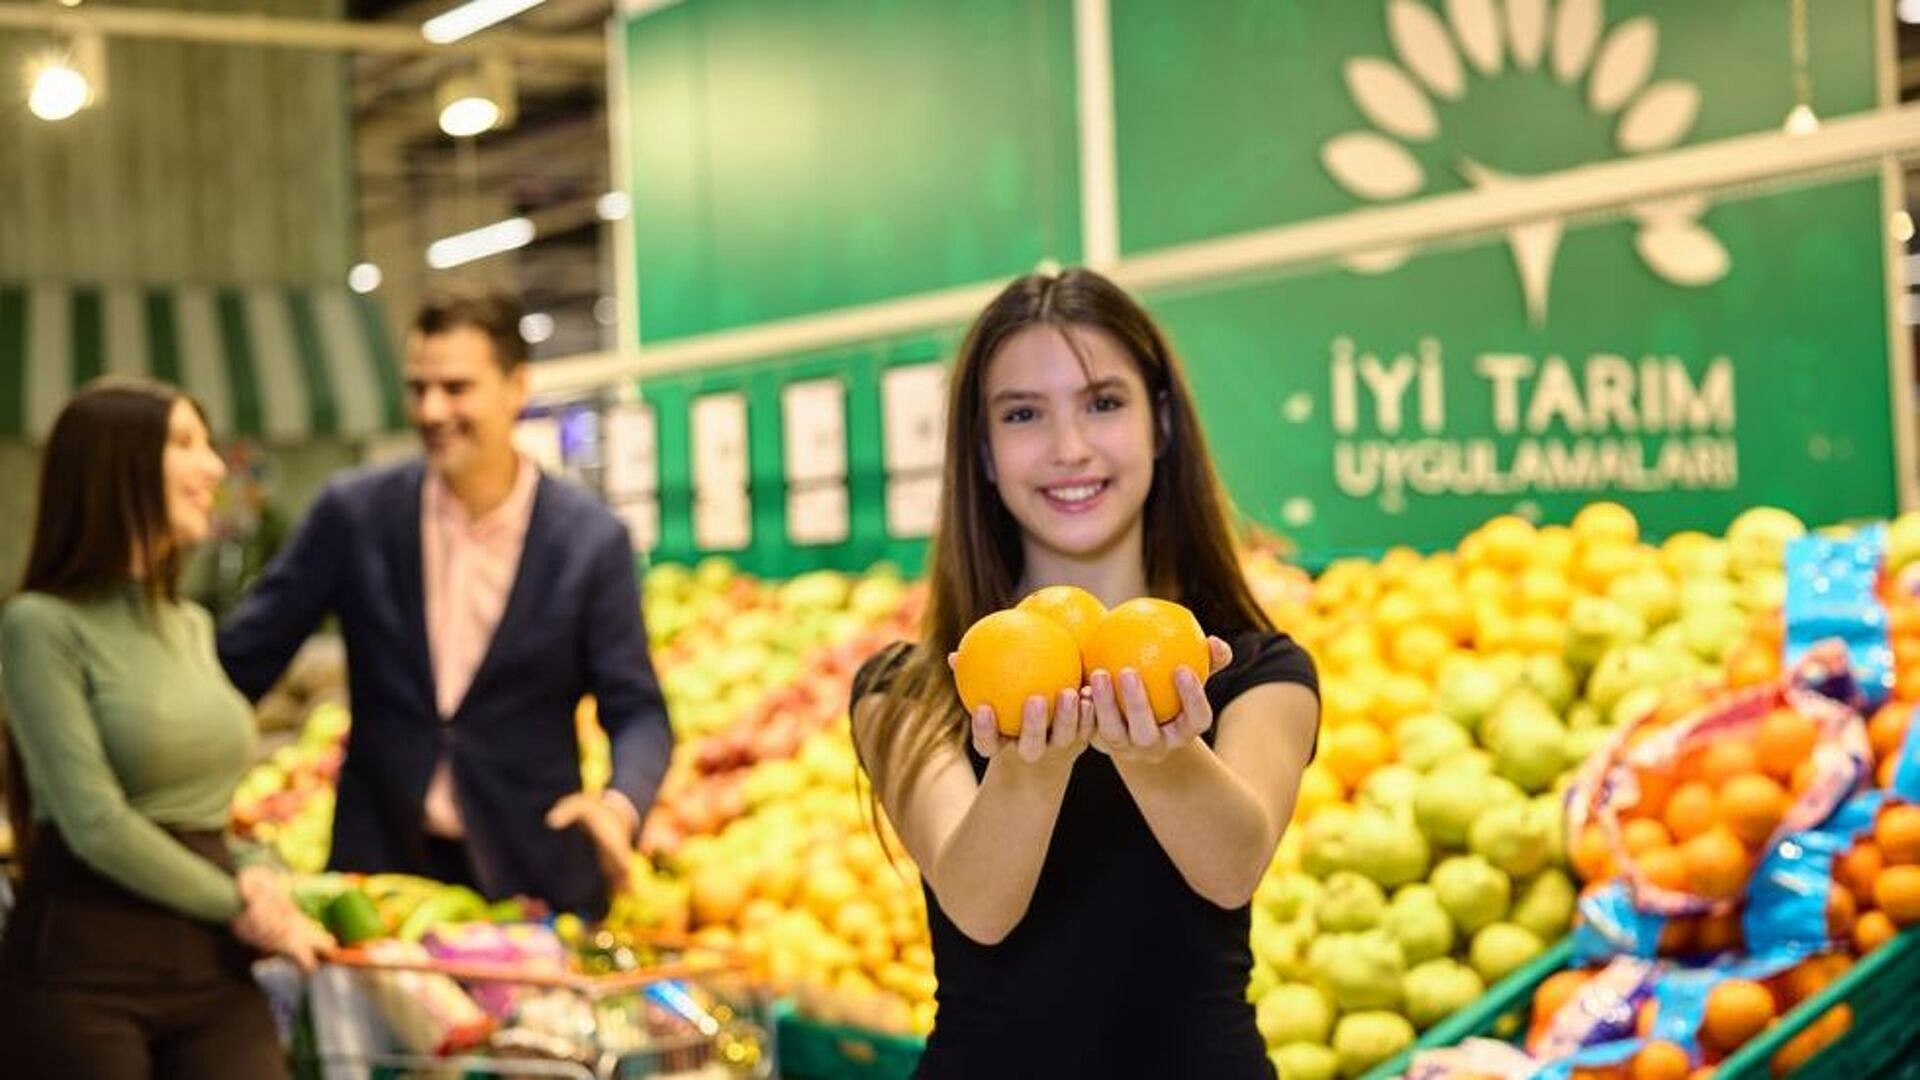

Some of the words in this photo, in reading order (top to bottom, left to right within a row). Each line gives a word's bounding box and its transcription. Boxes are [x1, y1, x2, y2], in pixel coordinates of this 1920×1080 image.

[1332, 337, 1444, 433] İYİ
[1475, 353, 1735, 434] TARIM
[1334, 438, 1738, 495] UYGULAMALARI
